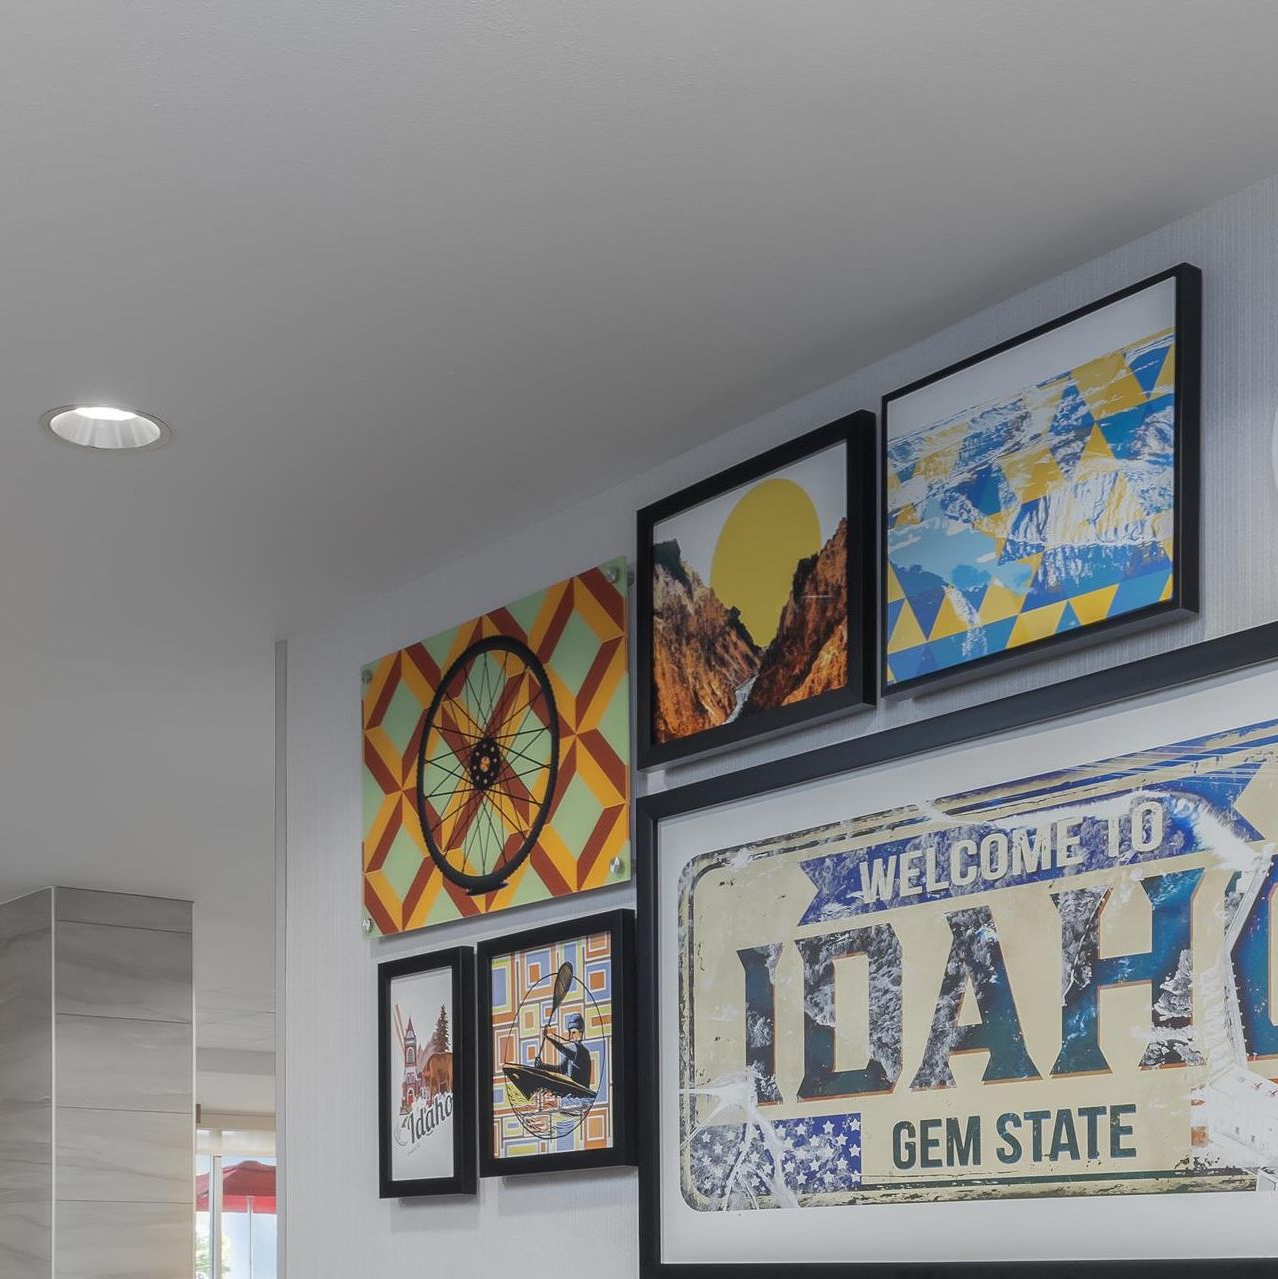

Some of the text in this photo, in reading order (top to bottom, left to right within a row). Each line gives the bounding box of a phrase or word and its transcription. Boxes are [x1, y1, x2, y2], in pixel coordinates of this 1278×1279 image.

[859, 800, 1164, 904] WELCOME TO
[400, 1093, 453, 1144] Idaho
[892, 1104, 1137, 1170] GEM STATE
